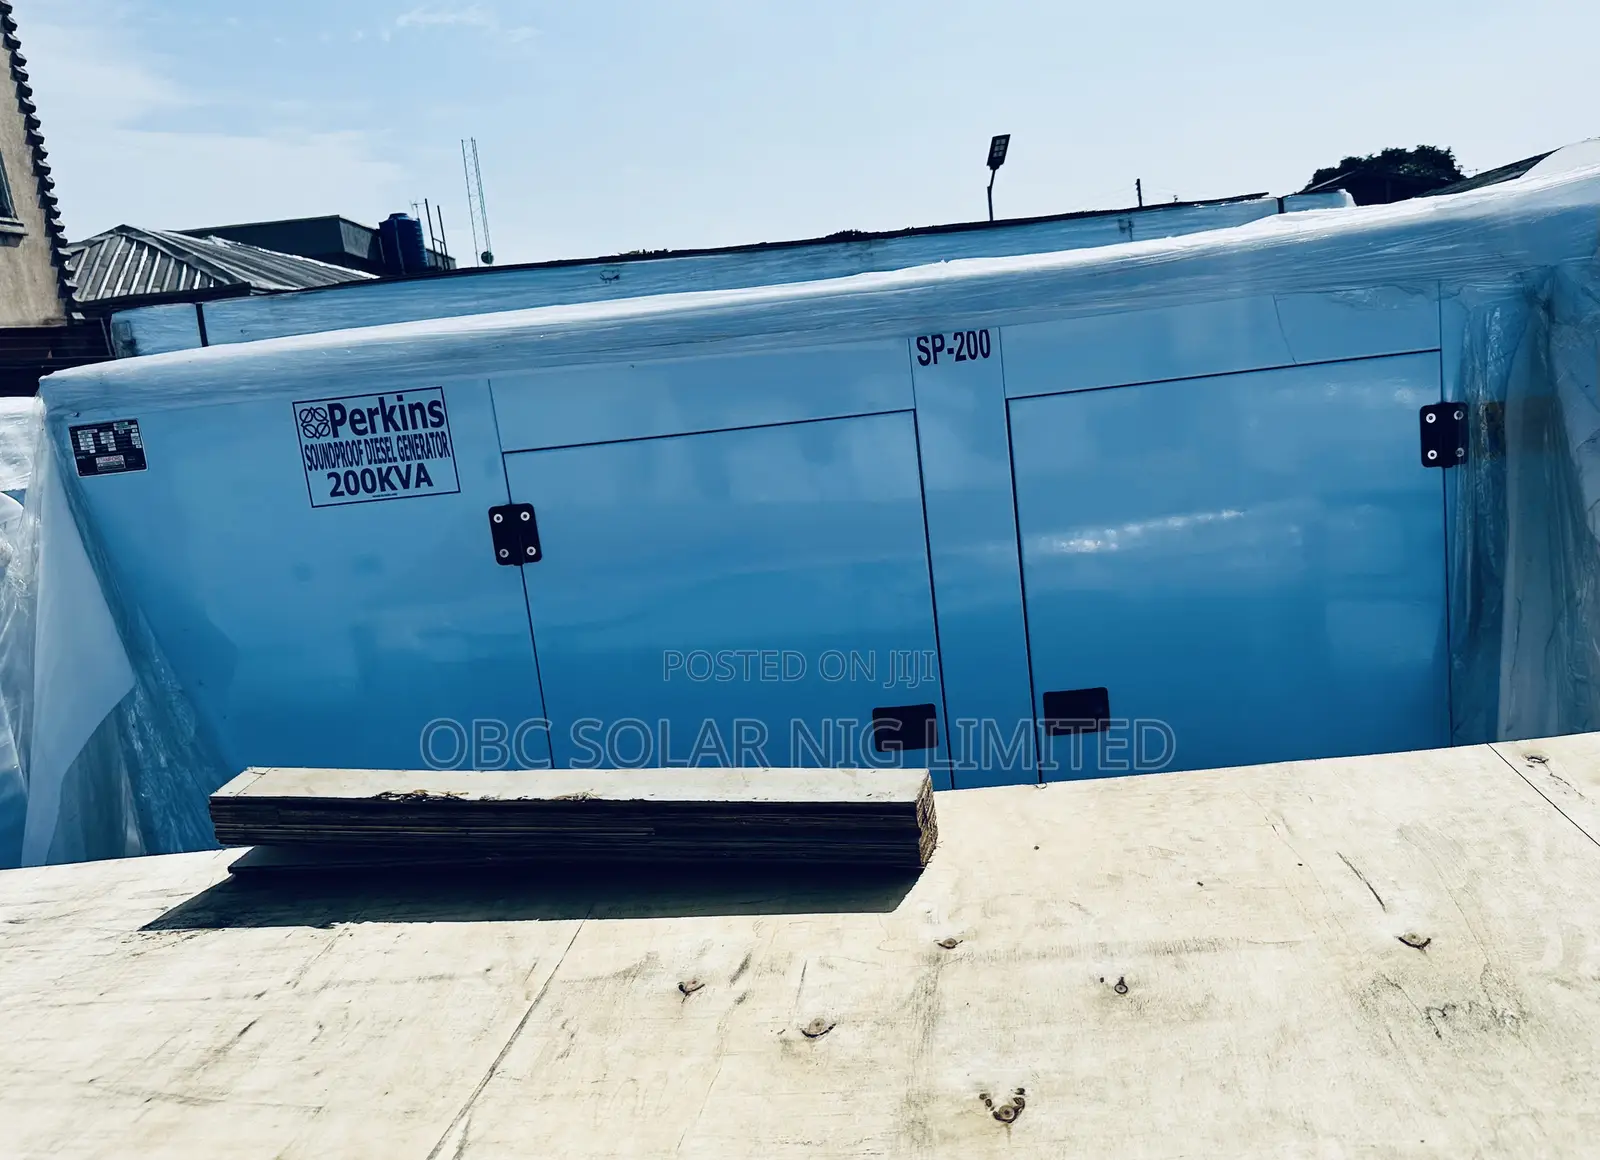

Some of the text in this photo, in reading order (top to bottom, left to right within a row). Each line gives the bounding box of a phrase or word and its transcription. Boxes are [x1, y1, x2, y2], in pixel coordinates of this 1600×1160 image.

[916, 329, 991, 366] SP-200
[327, 395, 445, 438] Perkins
[304, 431, 451, 472] SOUNDPROOF DIESEL GENERATOR
[327, 463, 434, 497] 200KVA
